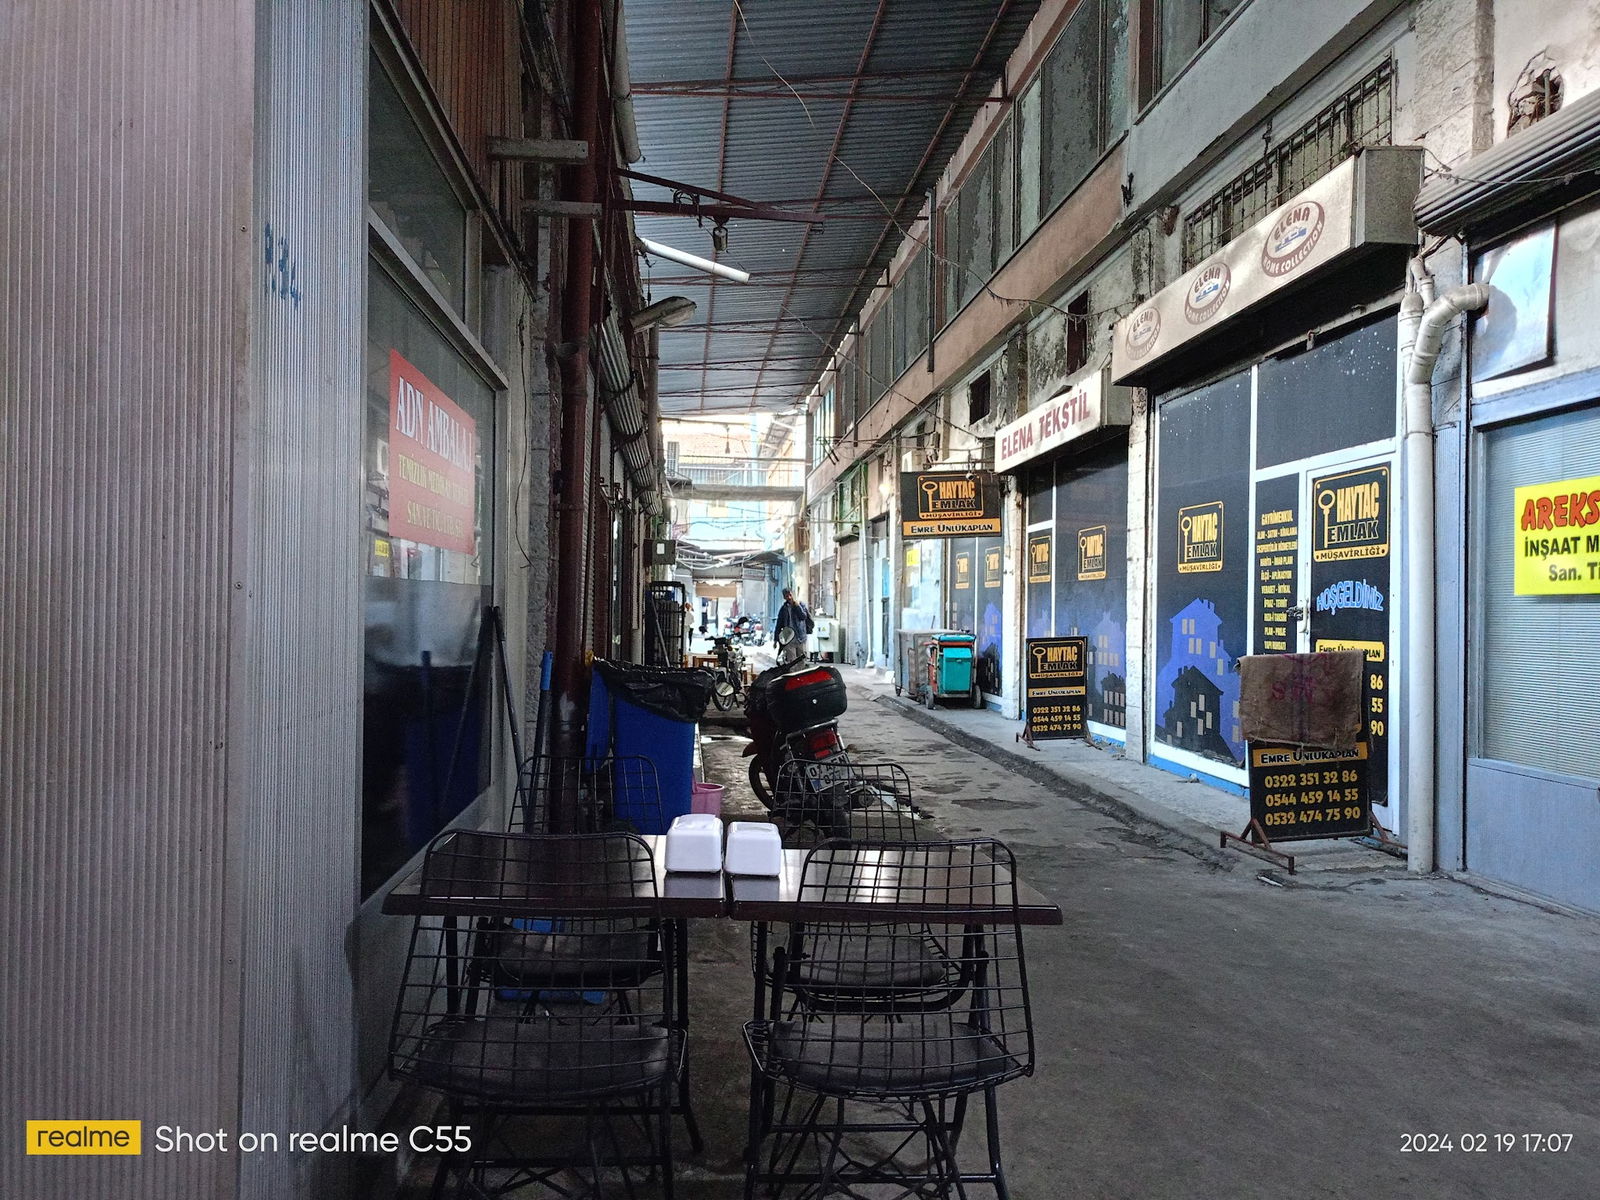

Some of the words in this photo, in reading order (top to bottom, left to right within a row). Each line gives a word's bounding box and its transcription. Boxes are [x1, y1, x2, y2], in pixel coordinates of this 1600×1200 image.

[1274, 207, 1311, 240] ELENA
[1280, 220, 1323, 273] COLLECTION
[1194, 267, 1221, 293] ELENA
[1132, 311, 1154, 333] ELENA
[395, 376, 424, 445] ADN
[426, 400, 473, 474] AMBALAJ
[1001, 422, 1034, 461] ELENA
[1039, 389, 1090, 441] TEKSTİL
[932, 499, 976, 509] EMLAK
[1336, 481, 1379, 523] HAYTAÇ
[1521, 490, 1600, 531] AREKS
[911, 525, 935, 534] EMRE
[1327, 520, 1379, 544] EMLAK
[1187, 542, 1218, 560] EMLAK
[1320, 546, 1381, 561] MÜŞAVİRLİĞİ
[1524, 536, 1581, 561] İNŞAAT
[1548, 564, 1582, 582] San.
[1316, 578, 1384, 615] HOŞGELDİNİZ
[1040, 661, 1078, 672] EMLAK
[1370, 674, 1384, 690] 86
[1371, 698, 1384, 714] 55
[1370, 720, 1384, 737] 90
[1261, 753, 1290, 764] EMRE
[1264, 775, 1297, 789] 0322
[1299, 773, 1320, 786] 351
[1323, 771, 1339, 785] 32
[1342, 770, 1358, 783] 86
[1265, 793, 1297, 807] 0544
[1300, 791, 1324, 805] 459
[1327, 790, 1341, 803] 14
[1344, 788, 1359, 801] 55
[1264, 811, 1297, 826] 0532
[1299, 810, 1323, 824] 474
[1326, 808, 1341, 822] 75
[1344, 806, 1361, 819] 90
